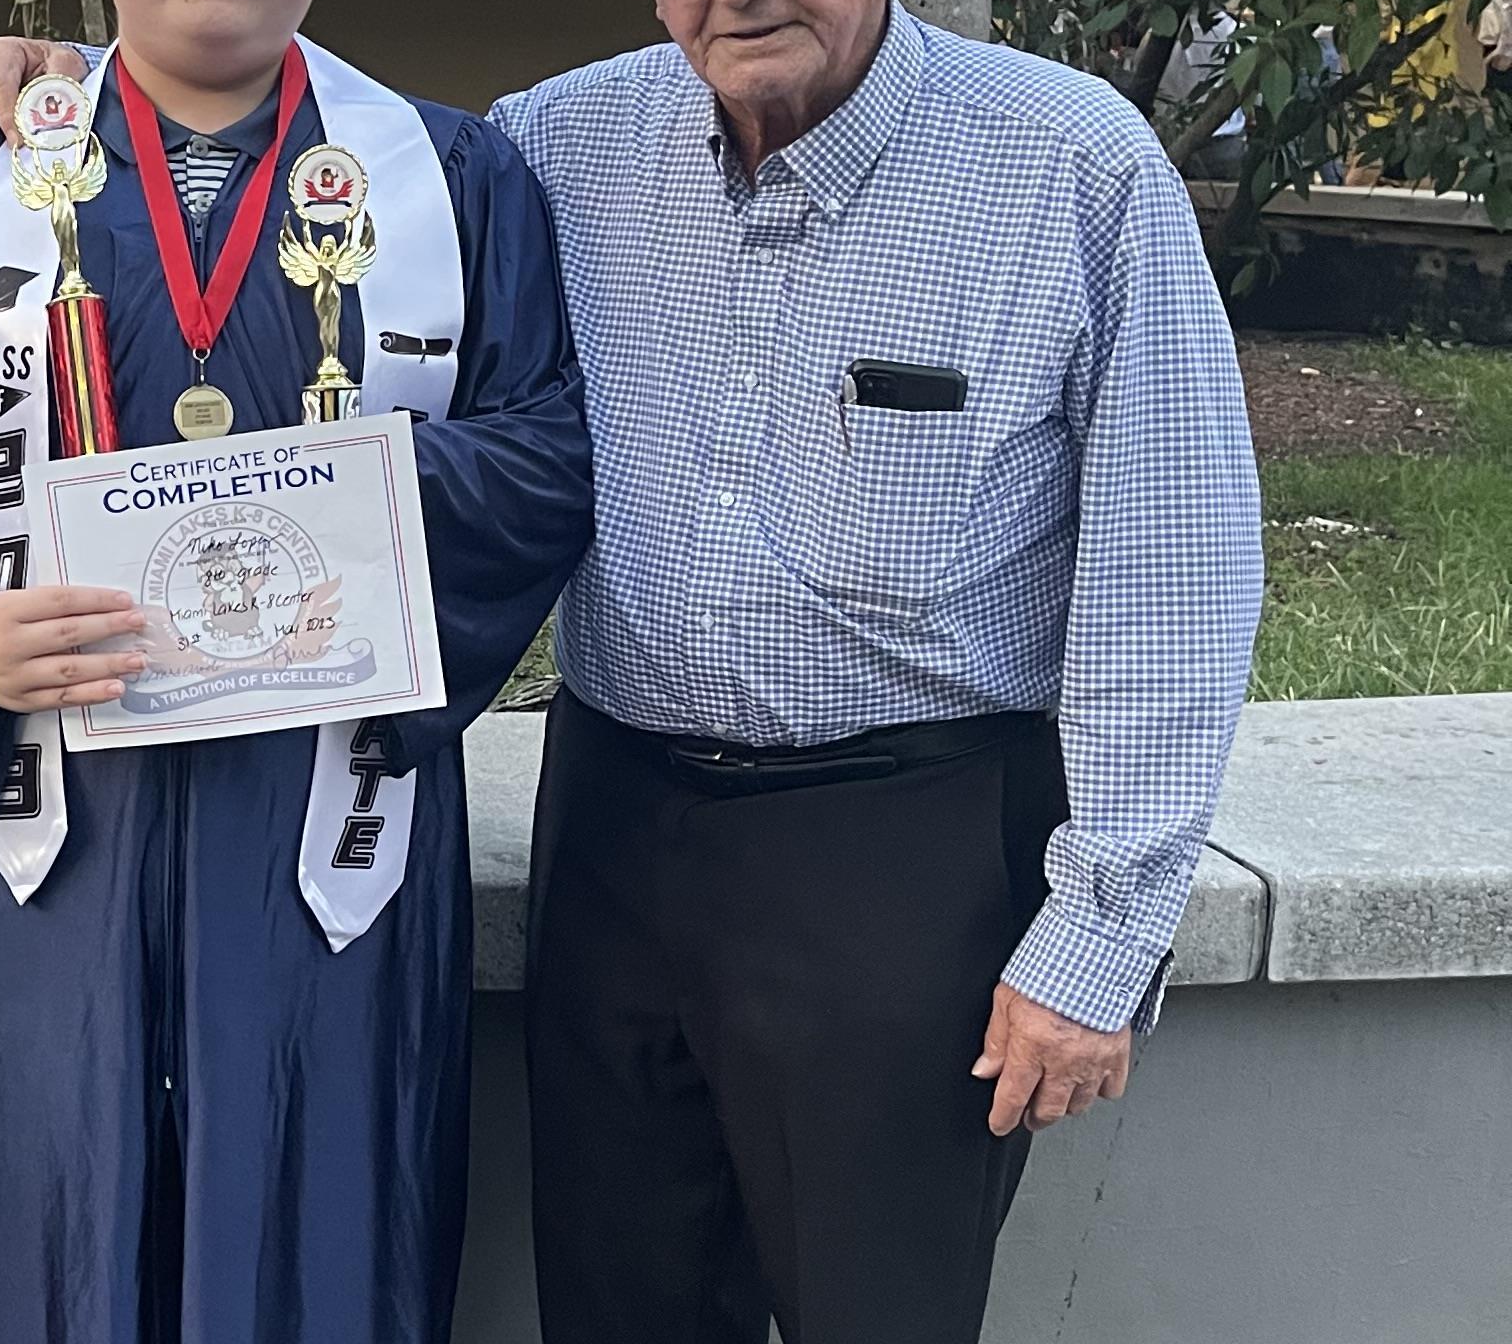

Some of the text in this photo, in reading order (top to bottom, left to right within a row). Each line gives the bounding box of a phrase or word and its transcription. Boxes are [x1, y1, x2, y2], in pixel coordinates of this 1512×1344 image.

[130, 446, 300, 483] CERTIFICATE OF
[102, 462, 335, 514] COMPLETION
[149, 505, 320, 601] MIAMI LAKES K-8 CENTER
[237, 562, 279, 585] grade
[149, 670, 356, 709] A TRADITION OF EXCELLENCE
